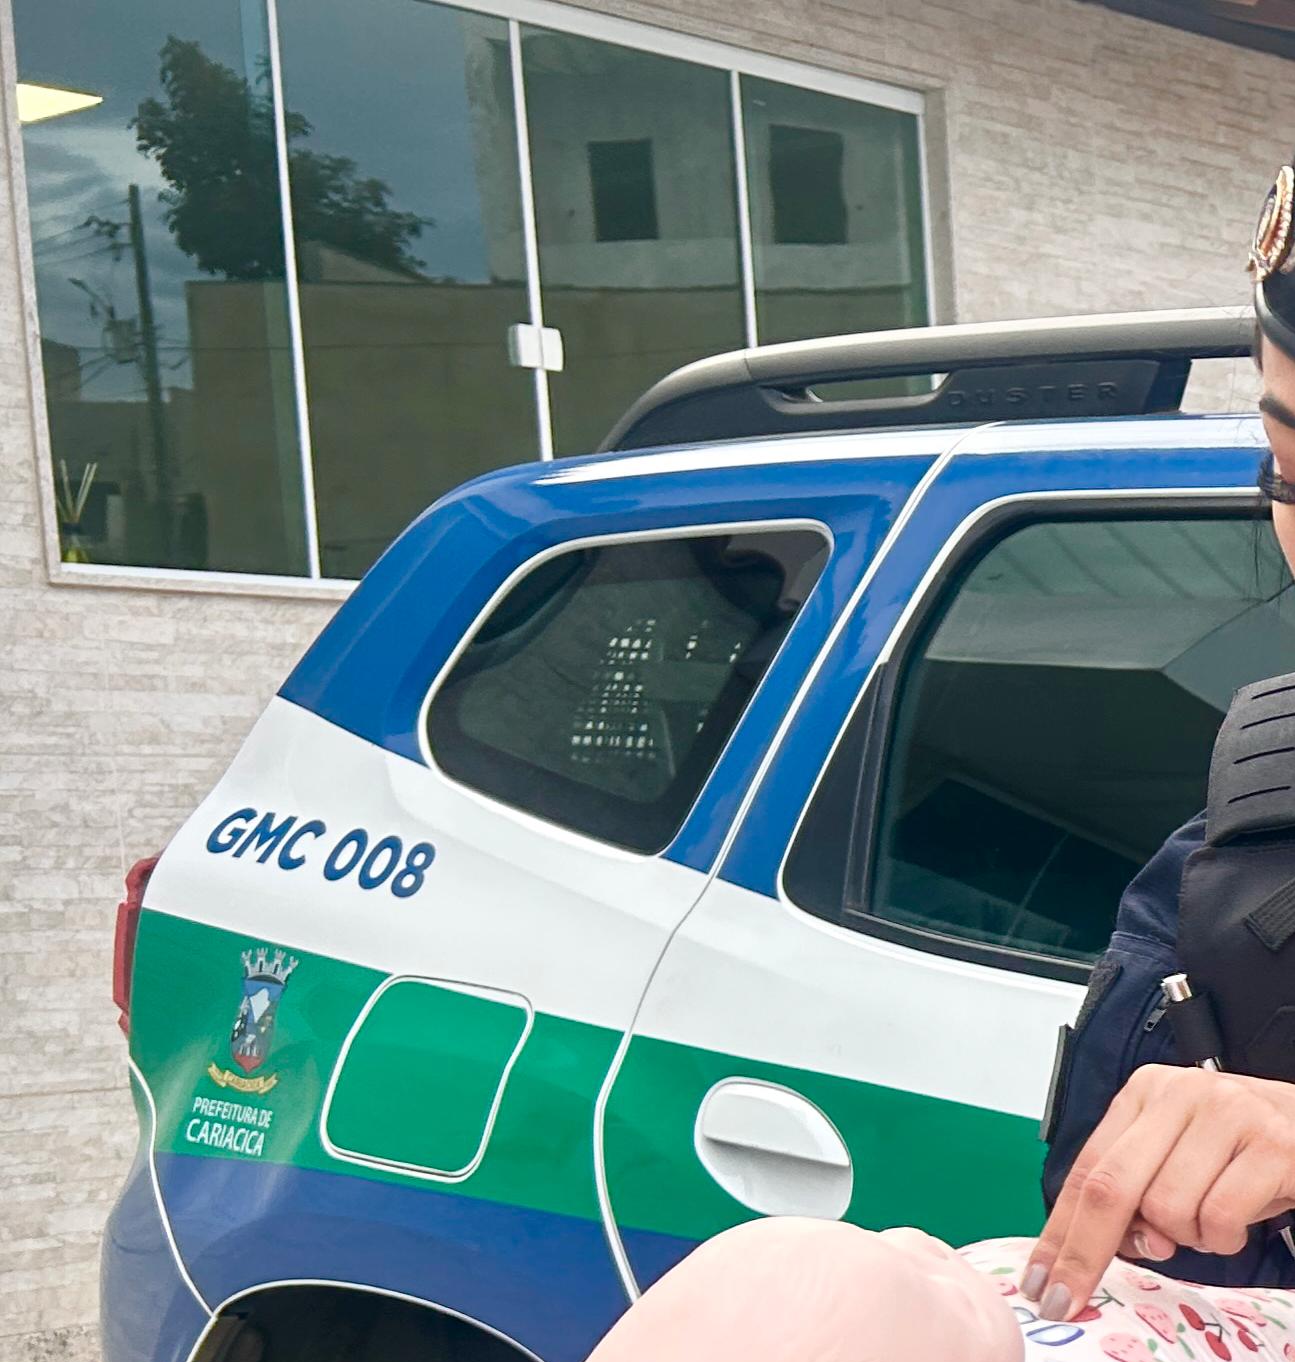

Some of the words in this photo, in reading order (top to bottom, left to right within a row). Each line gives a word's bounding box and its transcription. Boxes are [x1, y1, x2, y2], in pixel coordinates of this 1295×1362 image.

[947, 380, 1119, 405] DUSTER
[206, 806, 326, 870] GMC
[323, 828, 436, 898] 008
[192, 1096, 258, 1125] PREFEITURA
[257, 1110, 273, 1129] DE
[186, 1118, 265, 1157] CARIACICA
